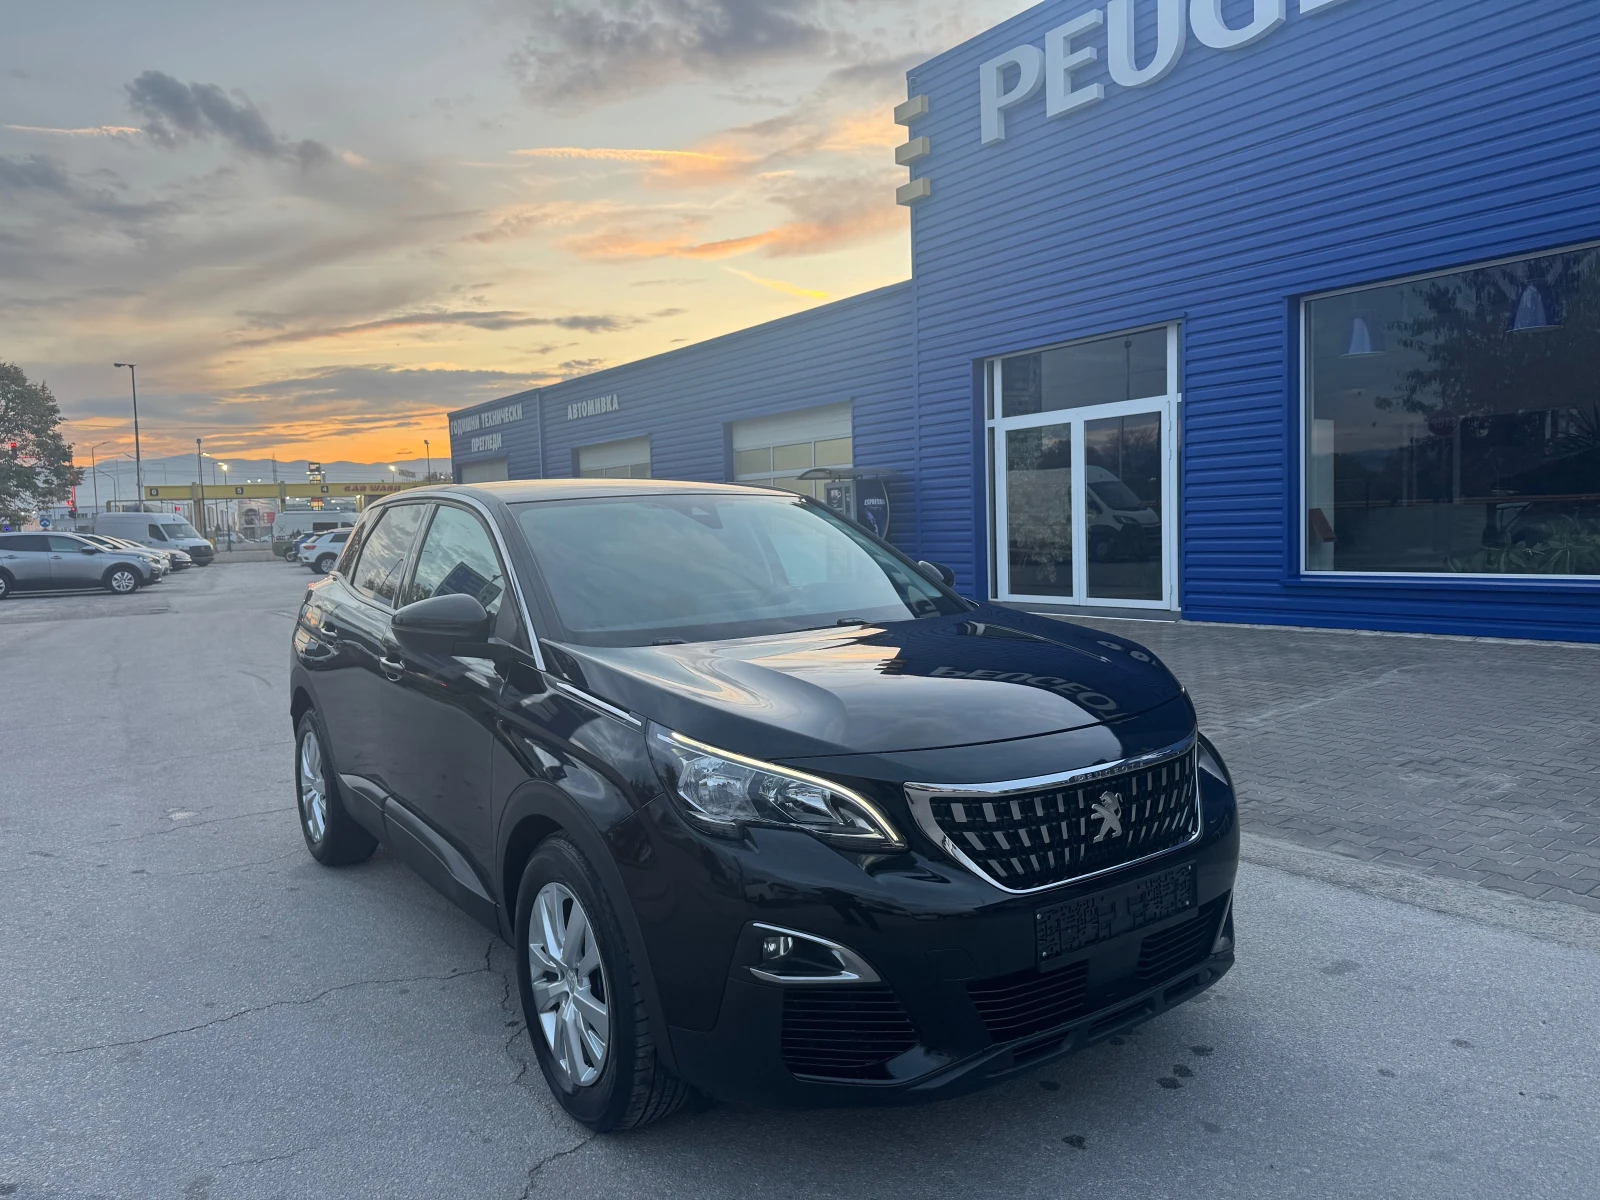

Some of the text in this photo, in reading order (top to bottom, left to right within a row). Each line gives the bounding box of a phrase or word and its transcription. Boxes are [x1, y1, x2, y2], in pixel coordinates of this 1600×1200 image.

[979, 0, 1338, 145] PEUG
[450, 403, 523, 436] ГОДИШНИ ТЕХНИЧЕСКИ
[567, 394, 619, 420] АВТОМИВКА
[471, 433, 502, 453] ПРЕГЛЕДИ
[1077, 763, 1135, 781] PEUGEOT
